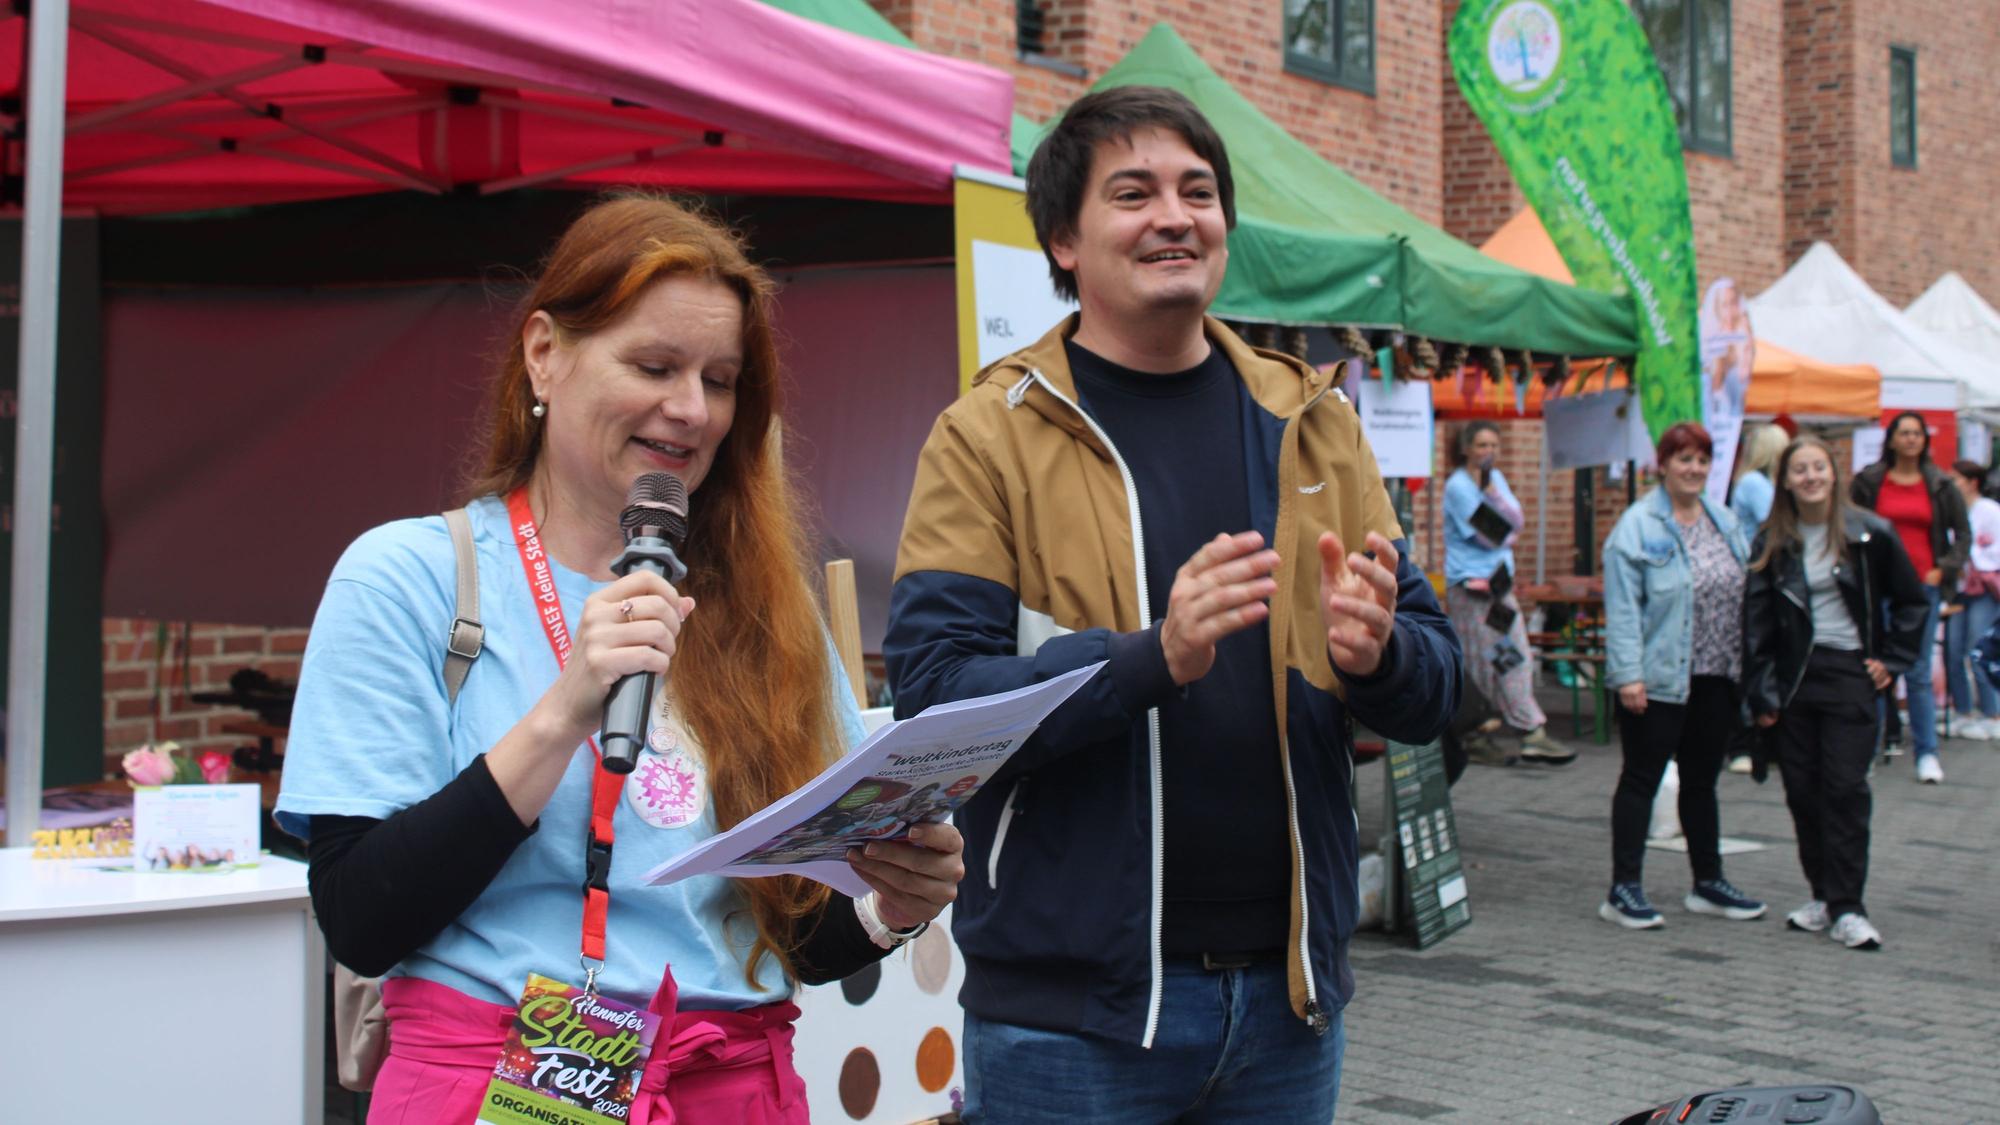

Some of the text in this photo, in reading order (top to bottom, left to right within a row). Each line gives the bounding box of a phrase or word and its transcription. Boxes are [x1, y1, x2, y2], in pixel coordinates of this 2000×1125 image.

[518, 520, 572, 665] ENNEF deine Stadt
[893, 739, 1013, 766] Weltkindertag
[520, 995, 644, 1067] Stadt
[570, 995, 646, 1031] Hennefer
[530, 1046, 615, 1099] Fest
[491, 1093, 585, 1125] ORGANISA
[592, 1097, 629, 1118] 2026
